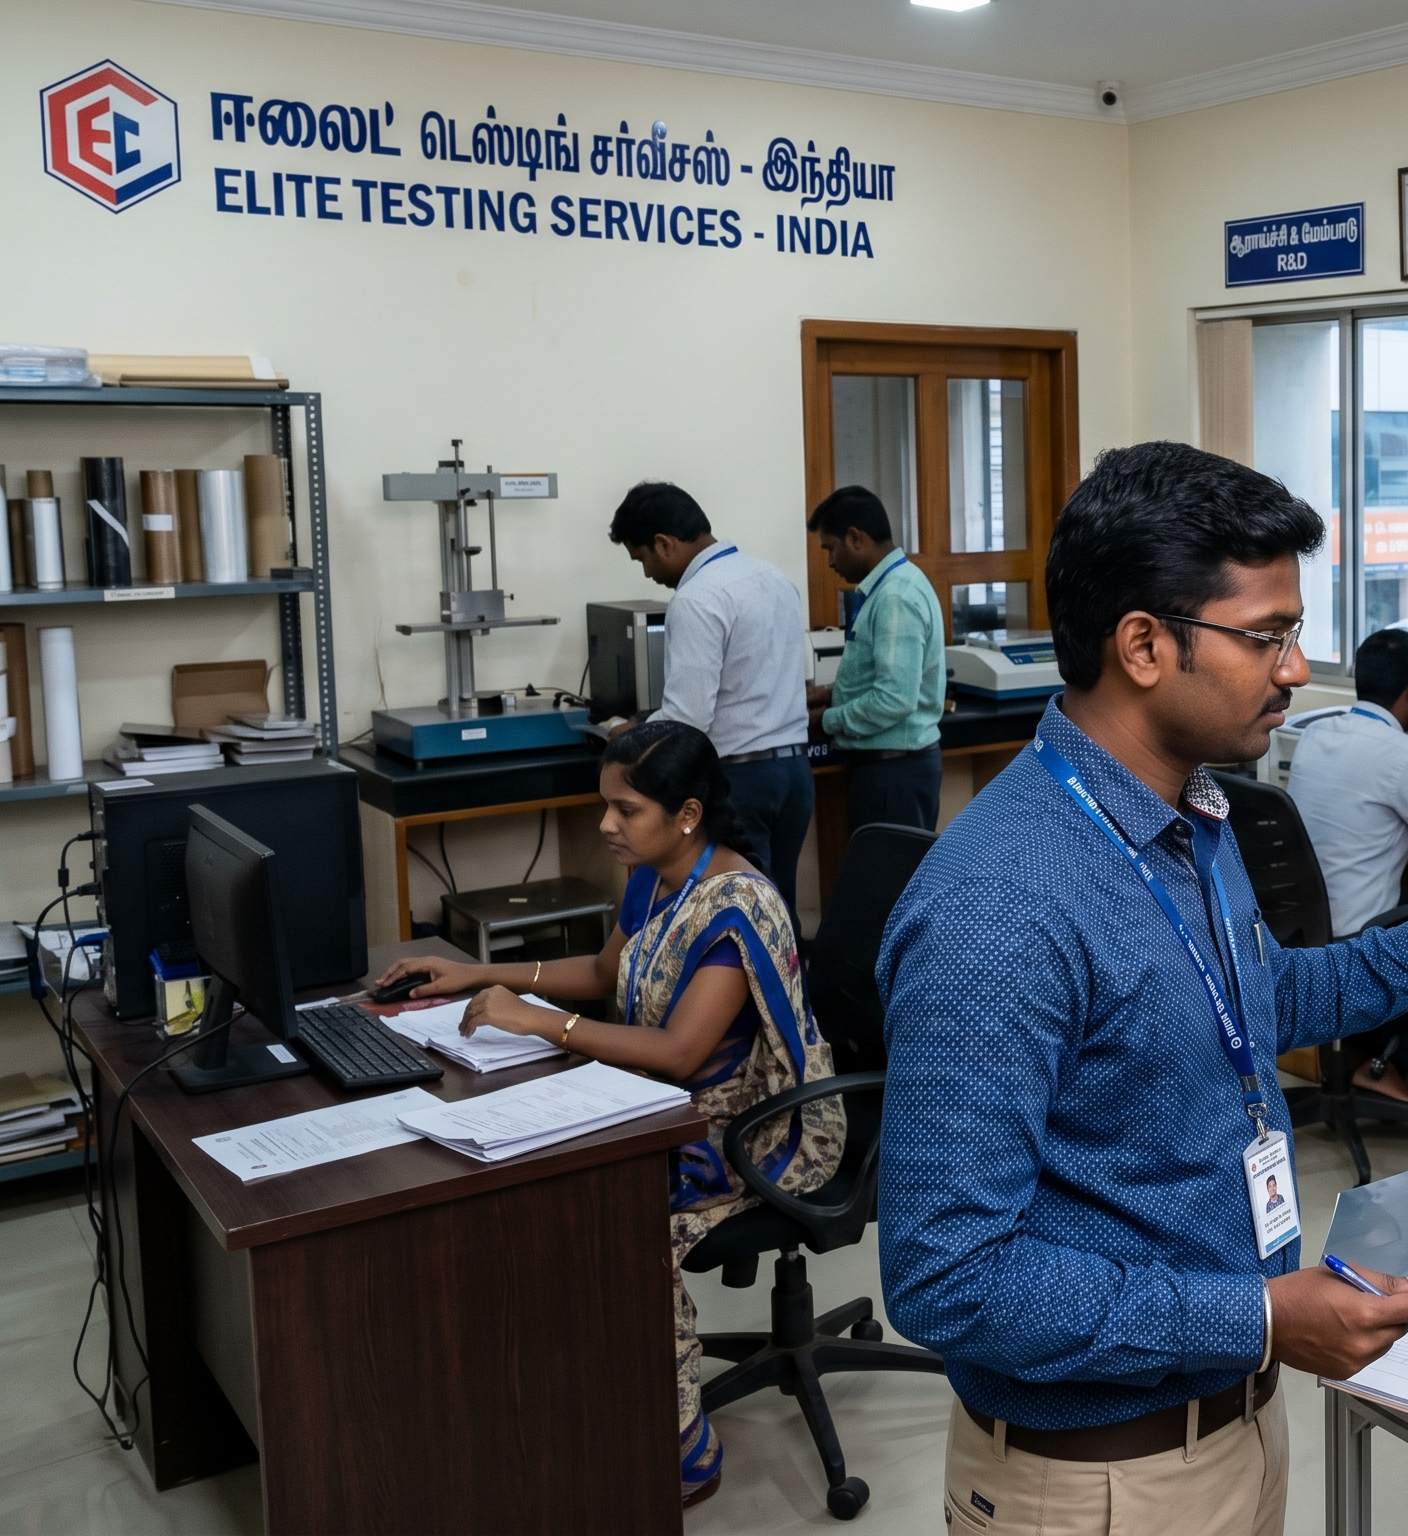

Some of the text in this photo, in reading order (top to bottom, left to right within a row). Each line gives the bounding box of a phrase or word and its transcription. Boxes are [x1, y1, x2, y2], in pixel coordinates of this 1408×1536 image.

[210, 92, 896, 212] ஈலைட் டெஸ்டிங் சர்வீசஸ் - இந்தியா
[214, 167, 343, 221] ELITE
[352, 179, 537, 234] TESTING
[551, 195, 742, 249] SERVICES
[776, 214, 874, 260] INDIA
[1230, 217, 1358, 258] ஆராய்ச்சி & மேம்பாடு
[1277, 252, 1308, 272] R&D
